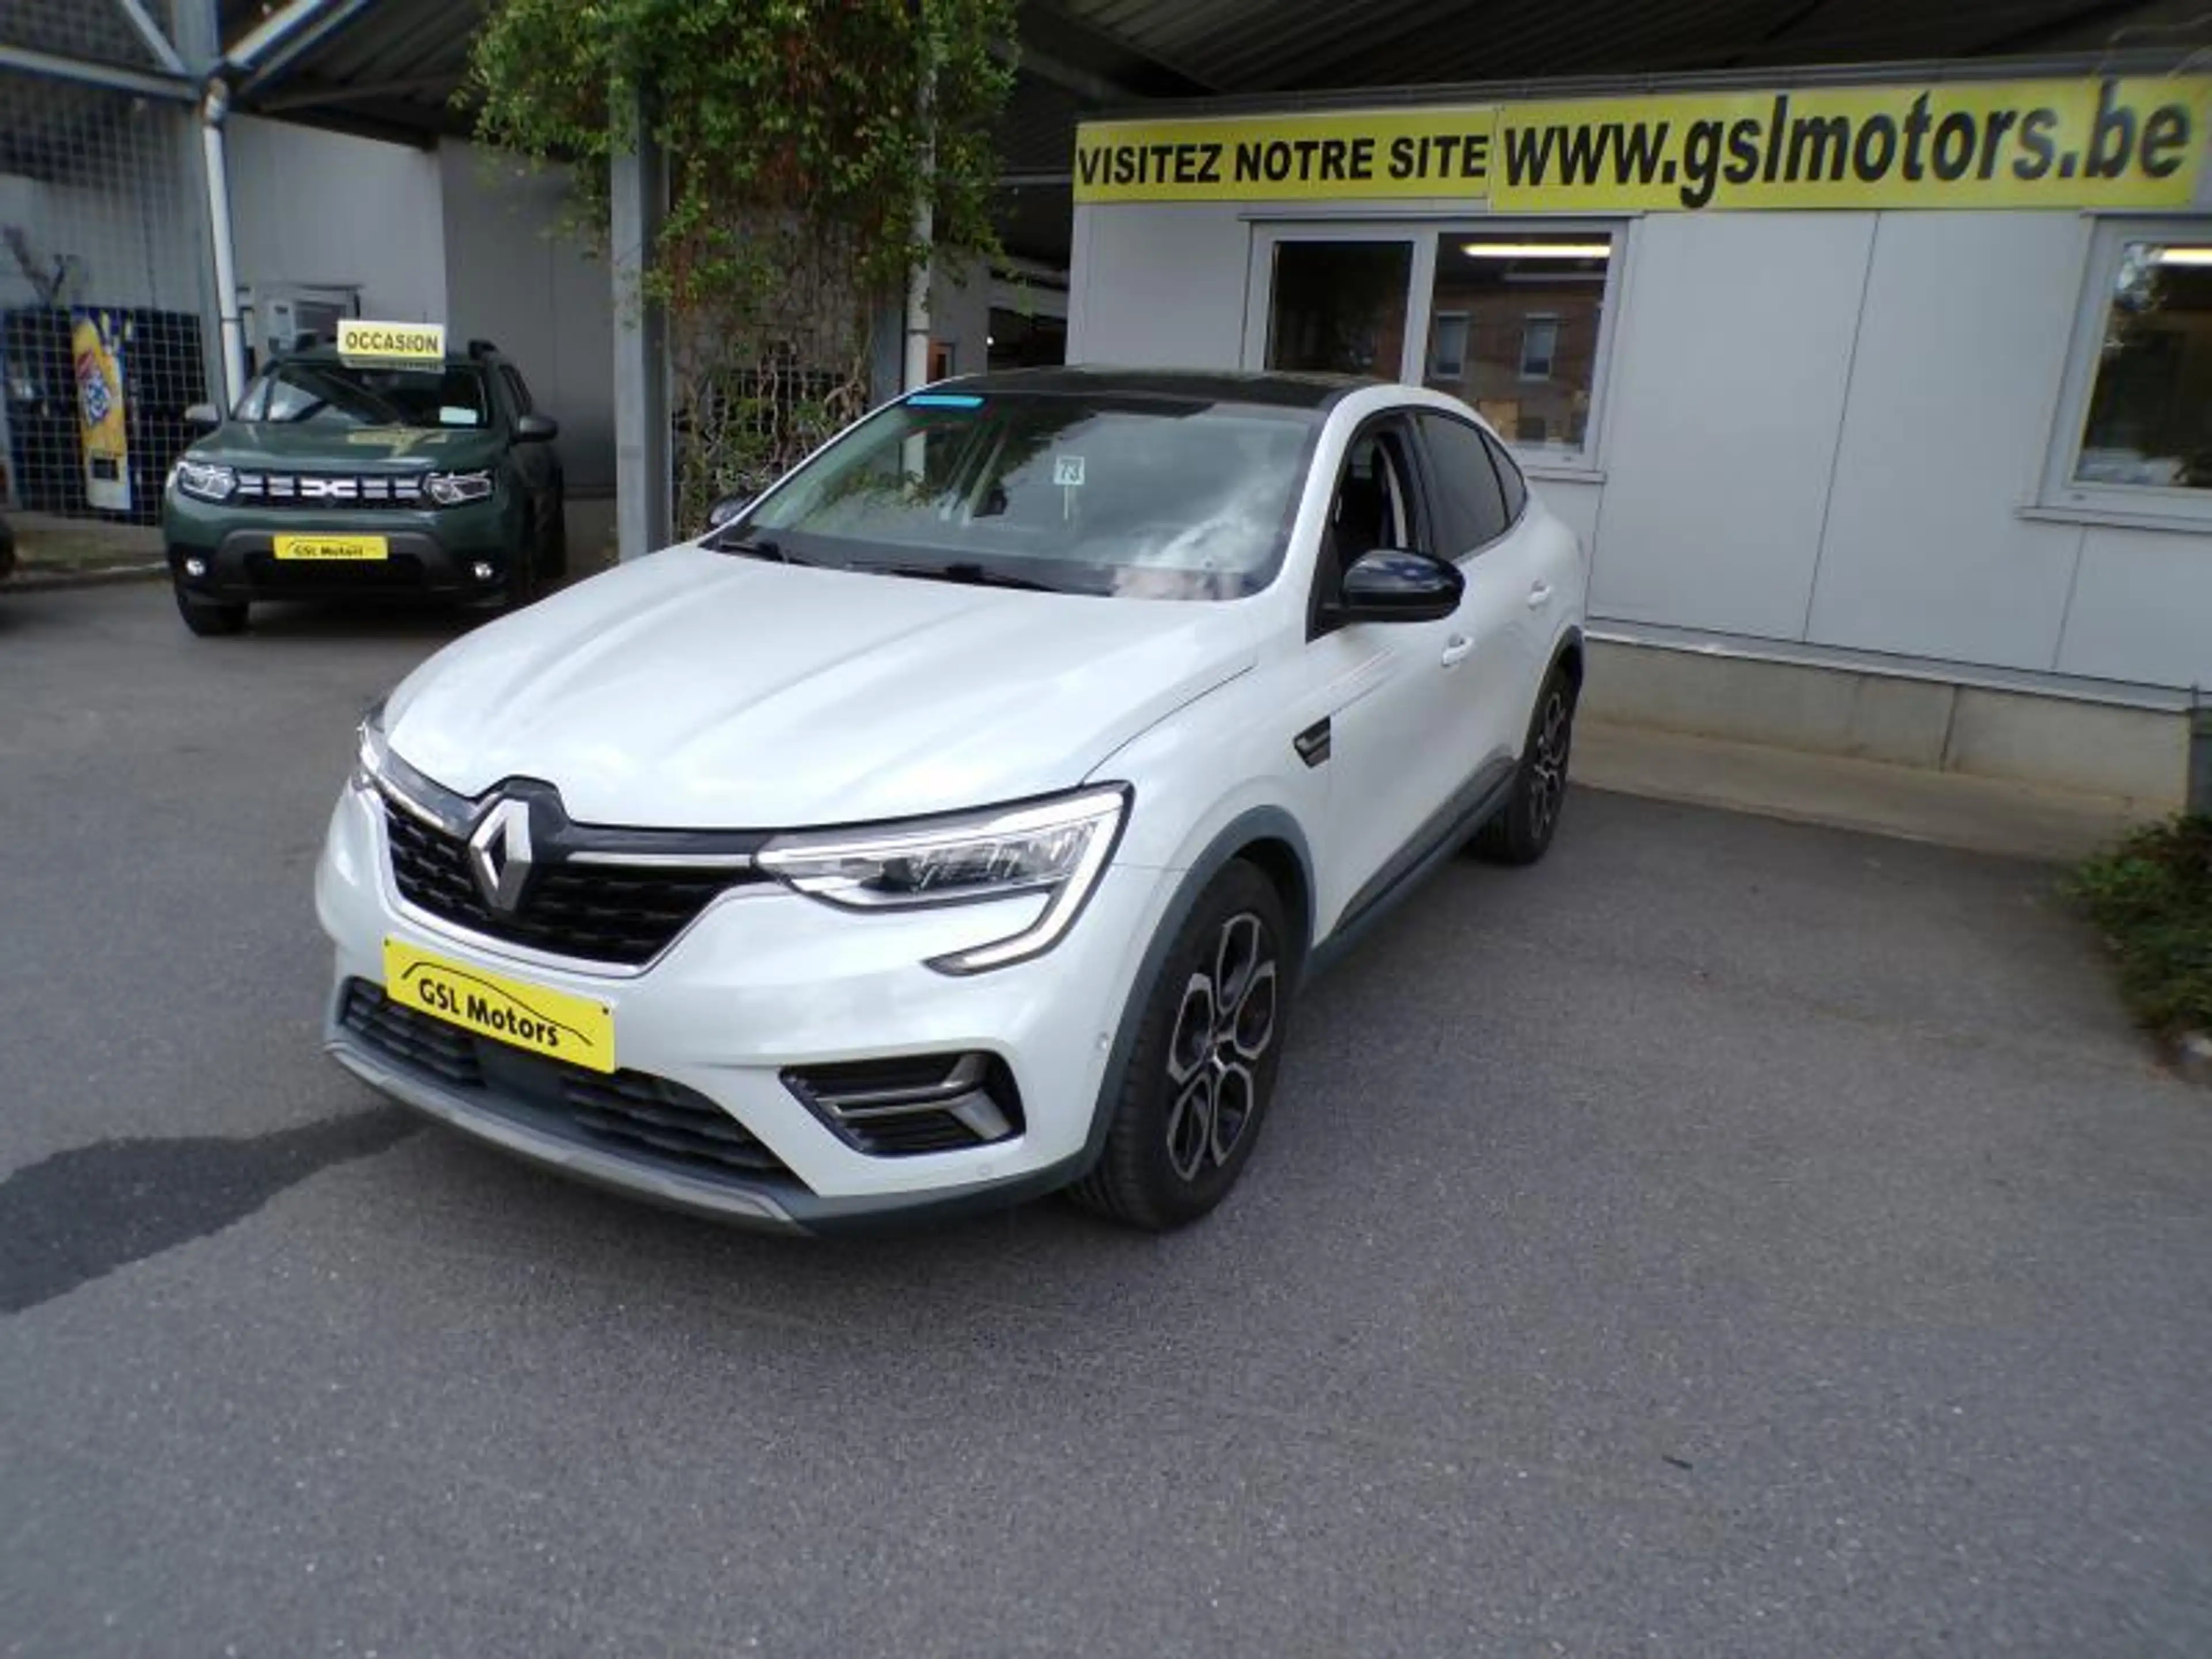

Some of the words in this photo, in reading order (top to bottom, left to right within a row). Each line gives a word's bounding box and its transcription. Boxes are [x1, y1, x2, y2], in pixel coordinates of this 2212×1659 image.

[1077, 142, 1222, 185] VISITEZ
[1234, 138, 1376, 183] NOTRE
[1388, 135, 1490, 180] SITE
[1503, 78, 2189, 210] www.gslmotors.be
[346, 331, 438, 353] OCCASION
[418, 978, 461, 1014] GSL
[467, 994, 560, 1047] Motors
